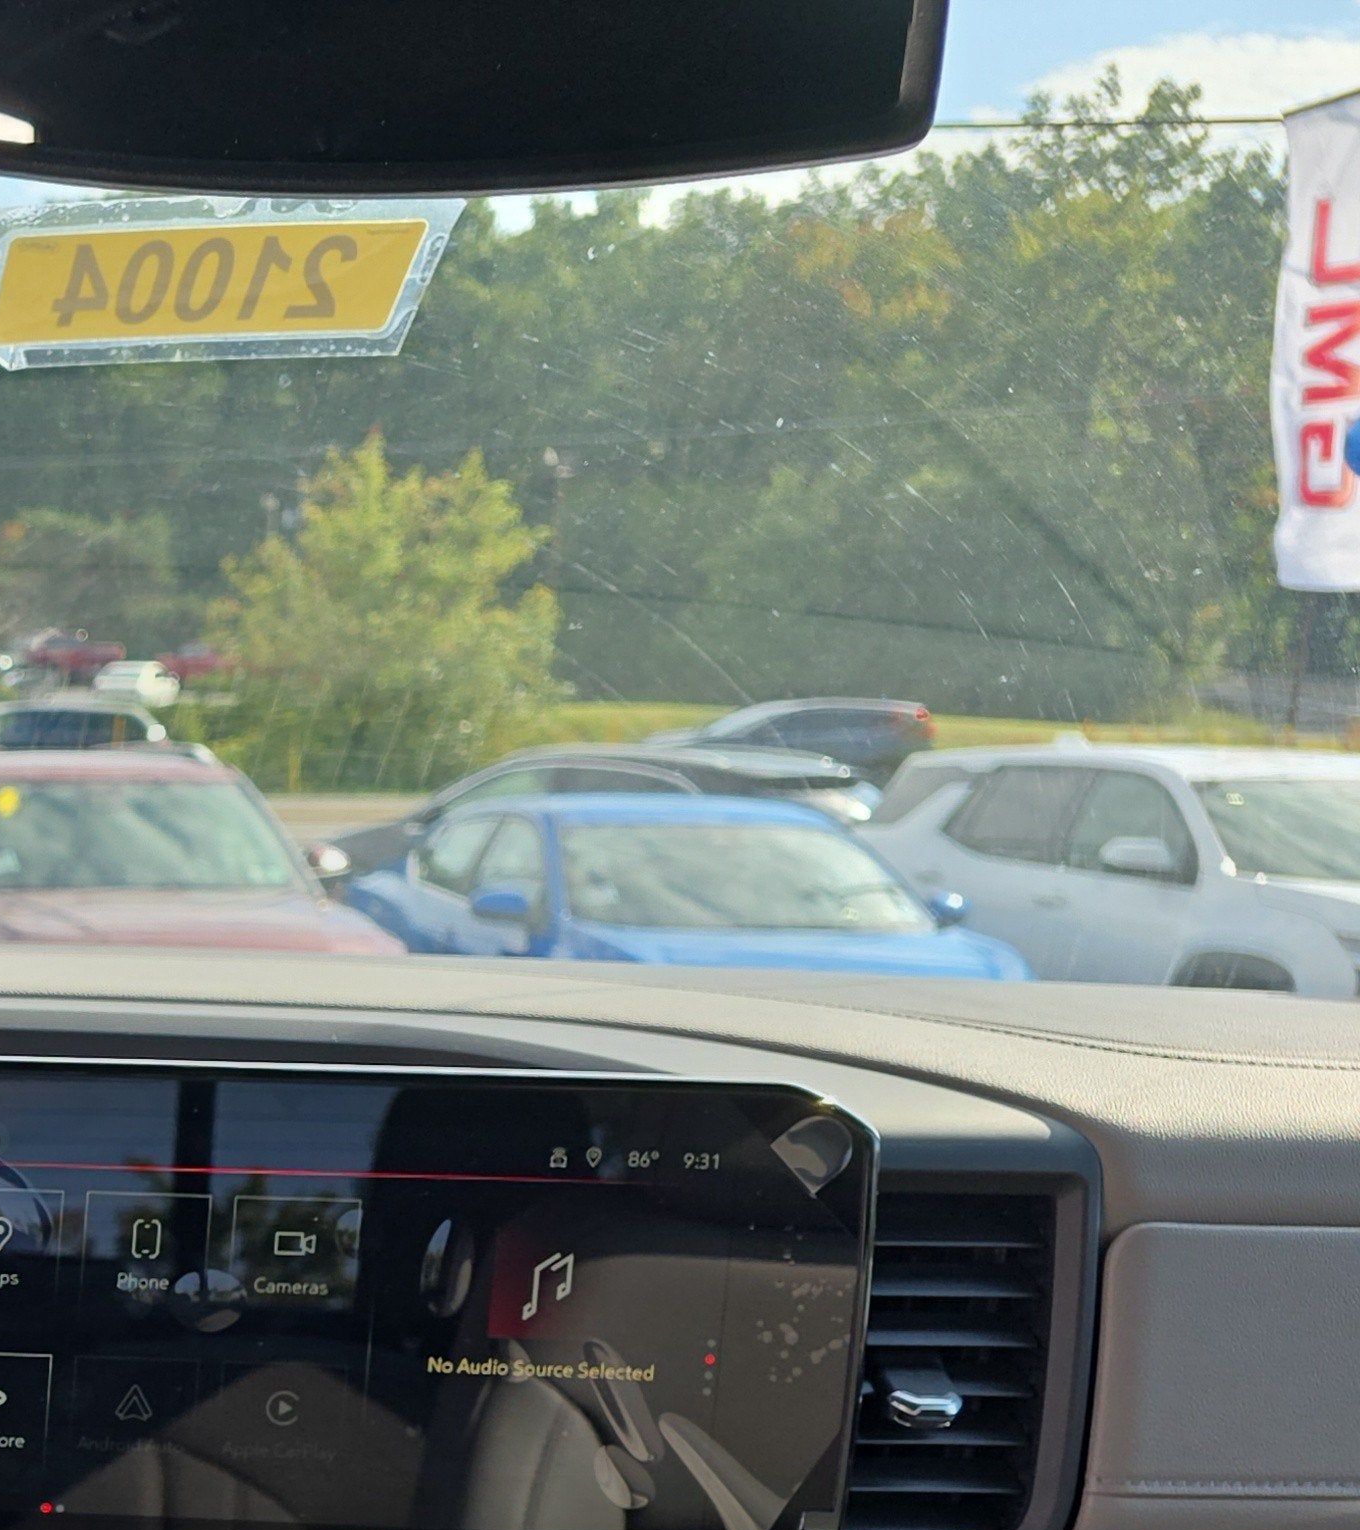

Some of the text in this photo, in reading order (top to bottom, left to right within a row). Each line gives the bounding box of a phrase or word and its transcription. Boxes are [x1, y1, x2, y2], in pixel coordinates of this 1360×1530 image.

[683, 1152, 719, 1170] 9:31
[116, 1271, 170, 1290] Phone
[254, 1276, 329, 1296] Cameras
[427, 1356, 655, 1381] No Audio Source Selected
